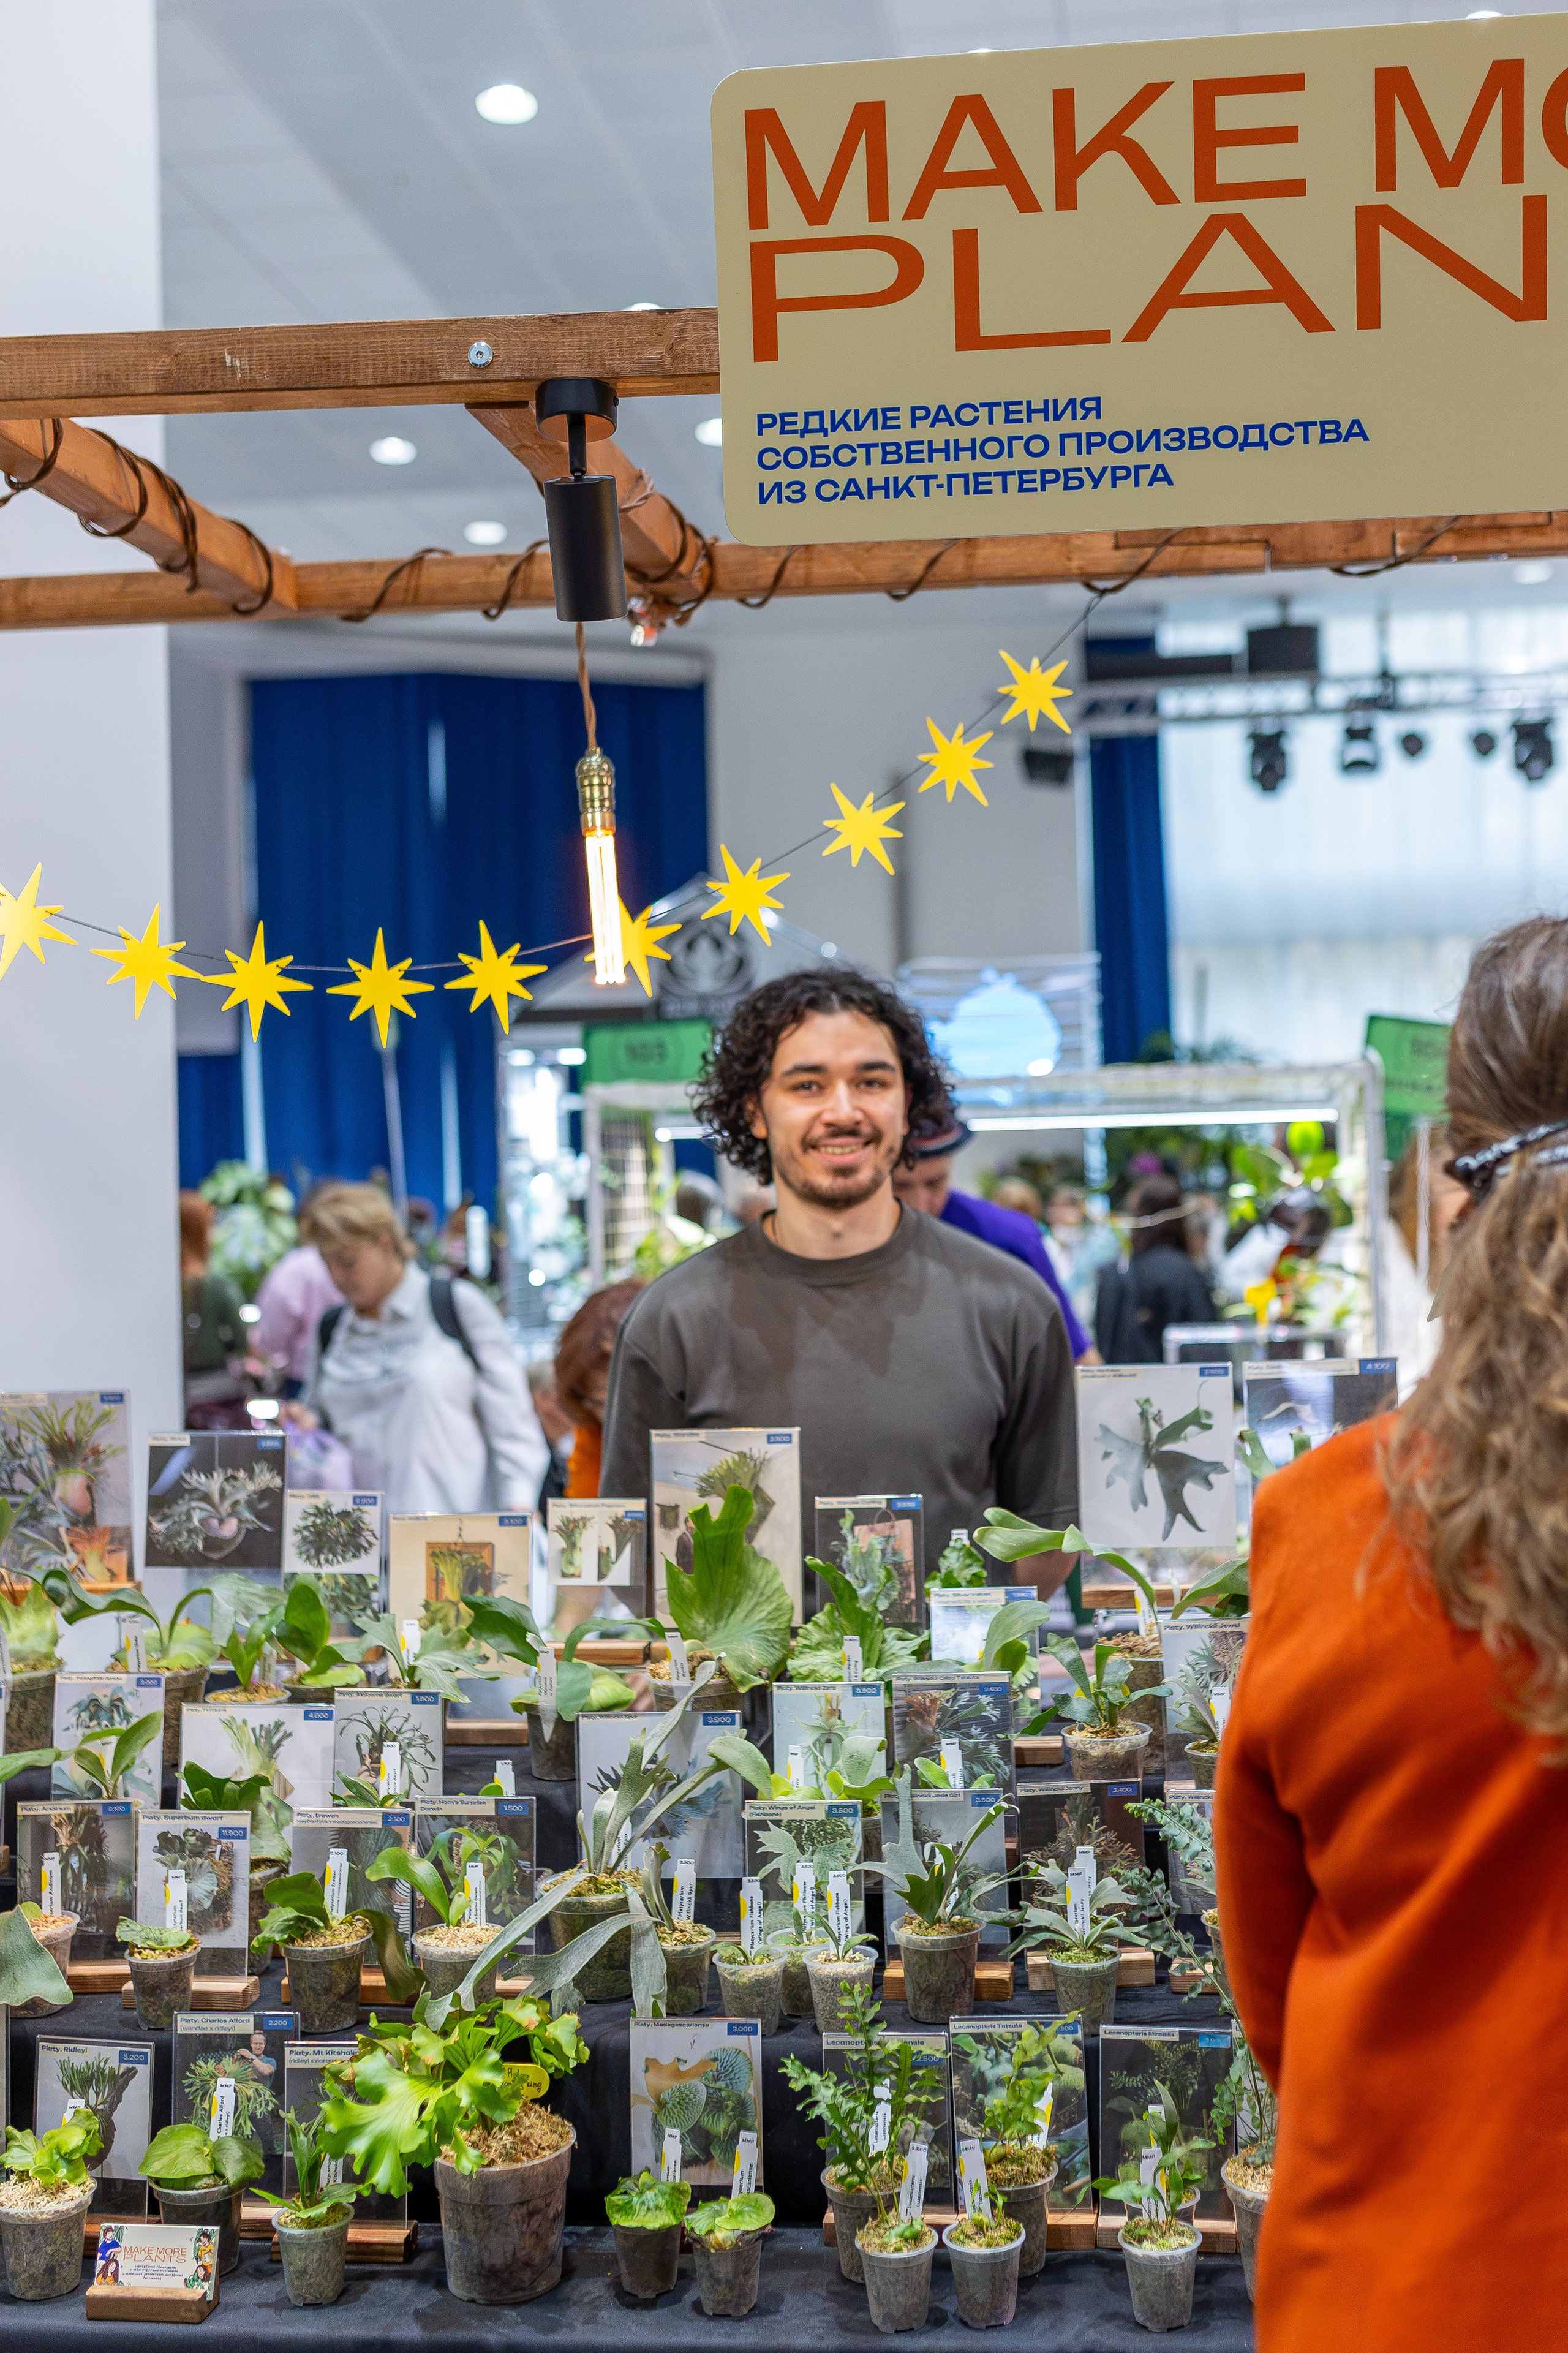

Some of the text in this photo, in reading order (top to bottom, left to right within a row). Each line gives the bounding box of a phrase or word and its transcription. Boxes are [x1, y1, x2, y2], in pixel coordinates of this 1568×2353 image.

[744, 58, 1568, 230] MAKE M
[748, 194, 1548, 363] PLAN
[757, 396, 1101, 439] РЕДКИЕ РАСТЕНИЯ
[757, 418, 1370, 470] СОБСТВЕННОГО ПРОИЗВОДСТВА
[759, 463, 1174, 505] ИЗ САНКТ-ПЕТЕРБУРГА
[123, 2253, 187, 2264] PLANTS
[124, 2245, 187, 2257] MAKE MORE
